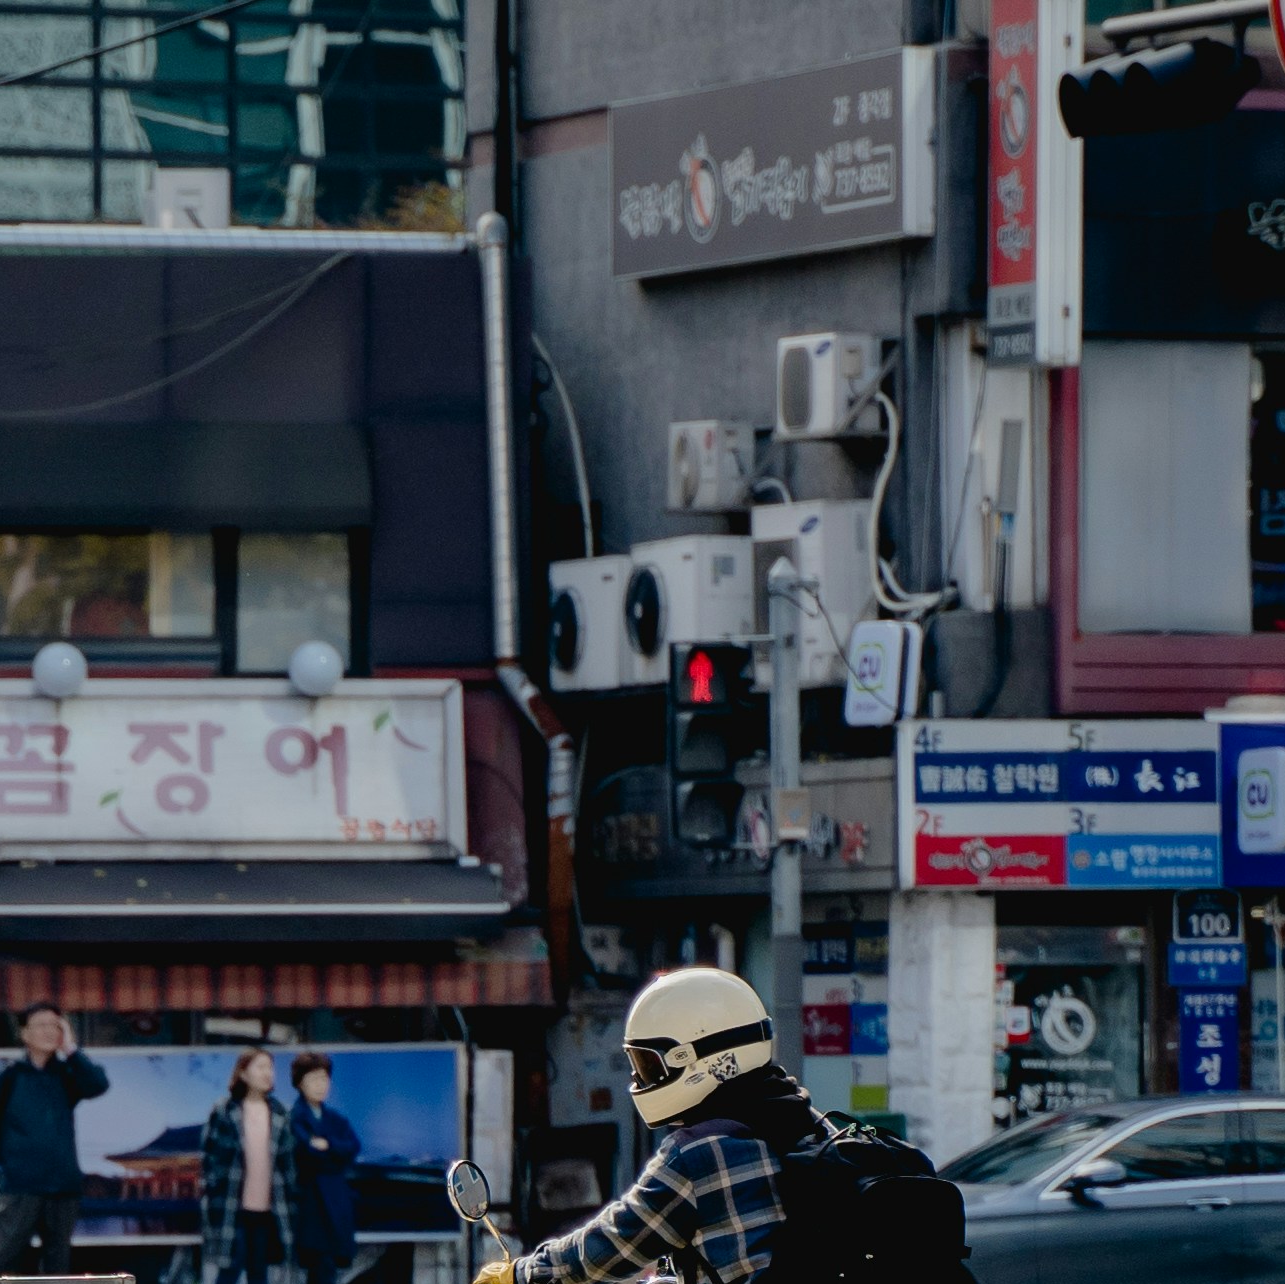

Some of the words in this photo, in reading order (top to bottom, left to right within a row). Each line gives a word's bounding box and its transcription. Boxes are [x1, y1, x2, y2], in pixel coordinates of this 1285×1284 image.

[915, 725, 942, 752] 4F
[1068, 724, 1096, 751] 5F
[1247, 784, 1269, 806] CU
[915, 809, 944, 836] 2F
[1069, 808, 1097, 835] 3F
[1188, 913, 1232, 937] 100
